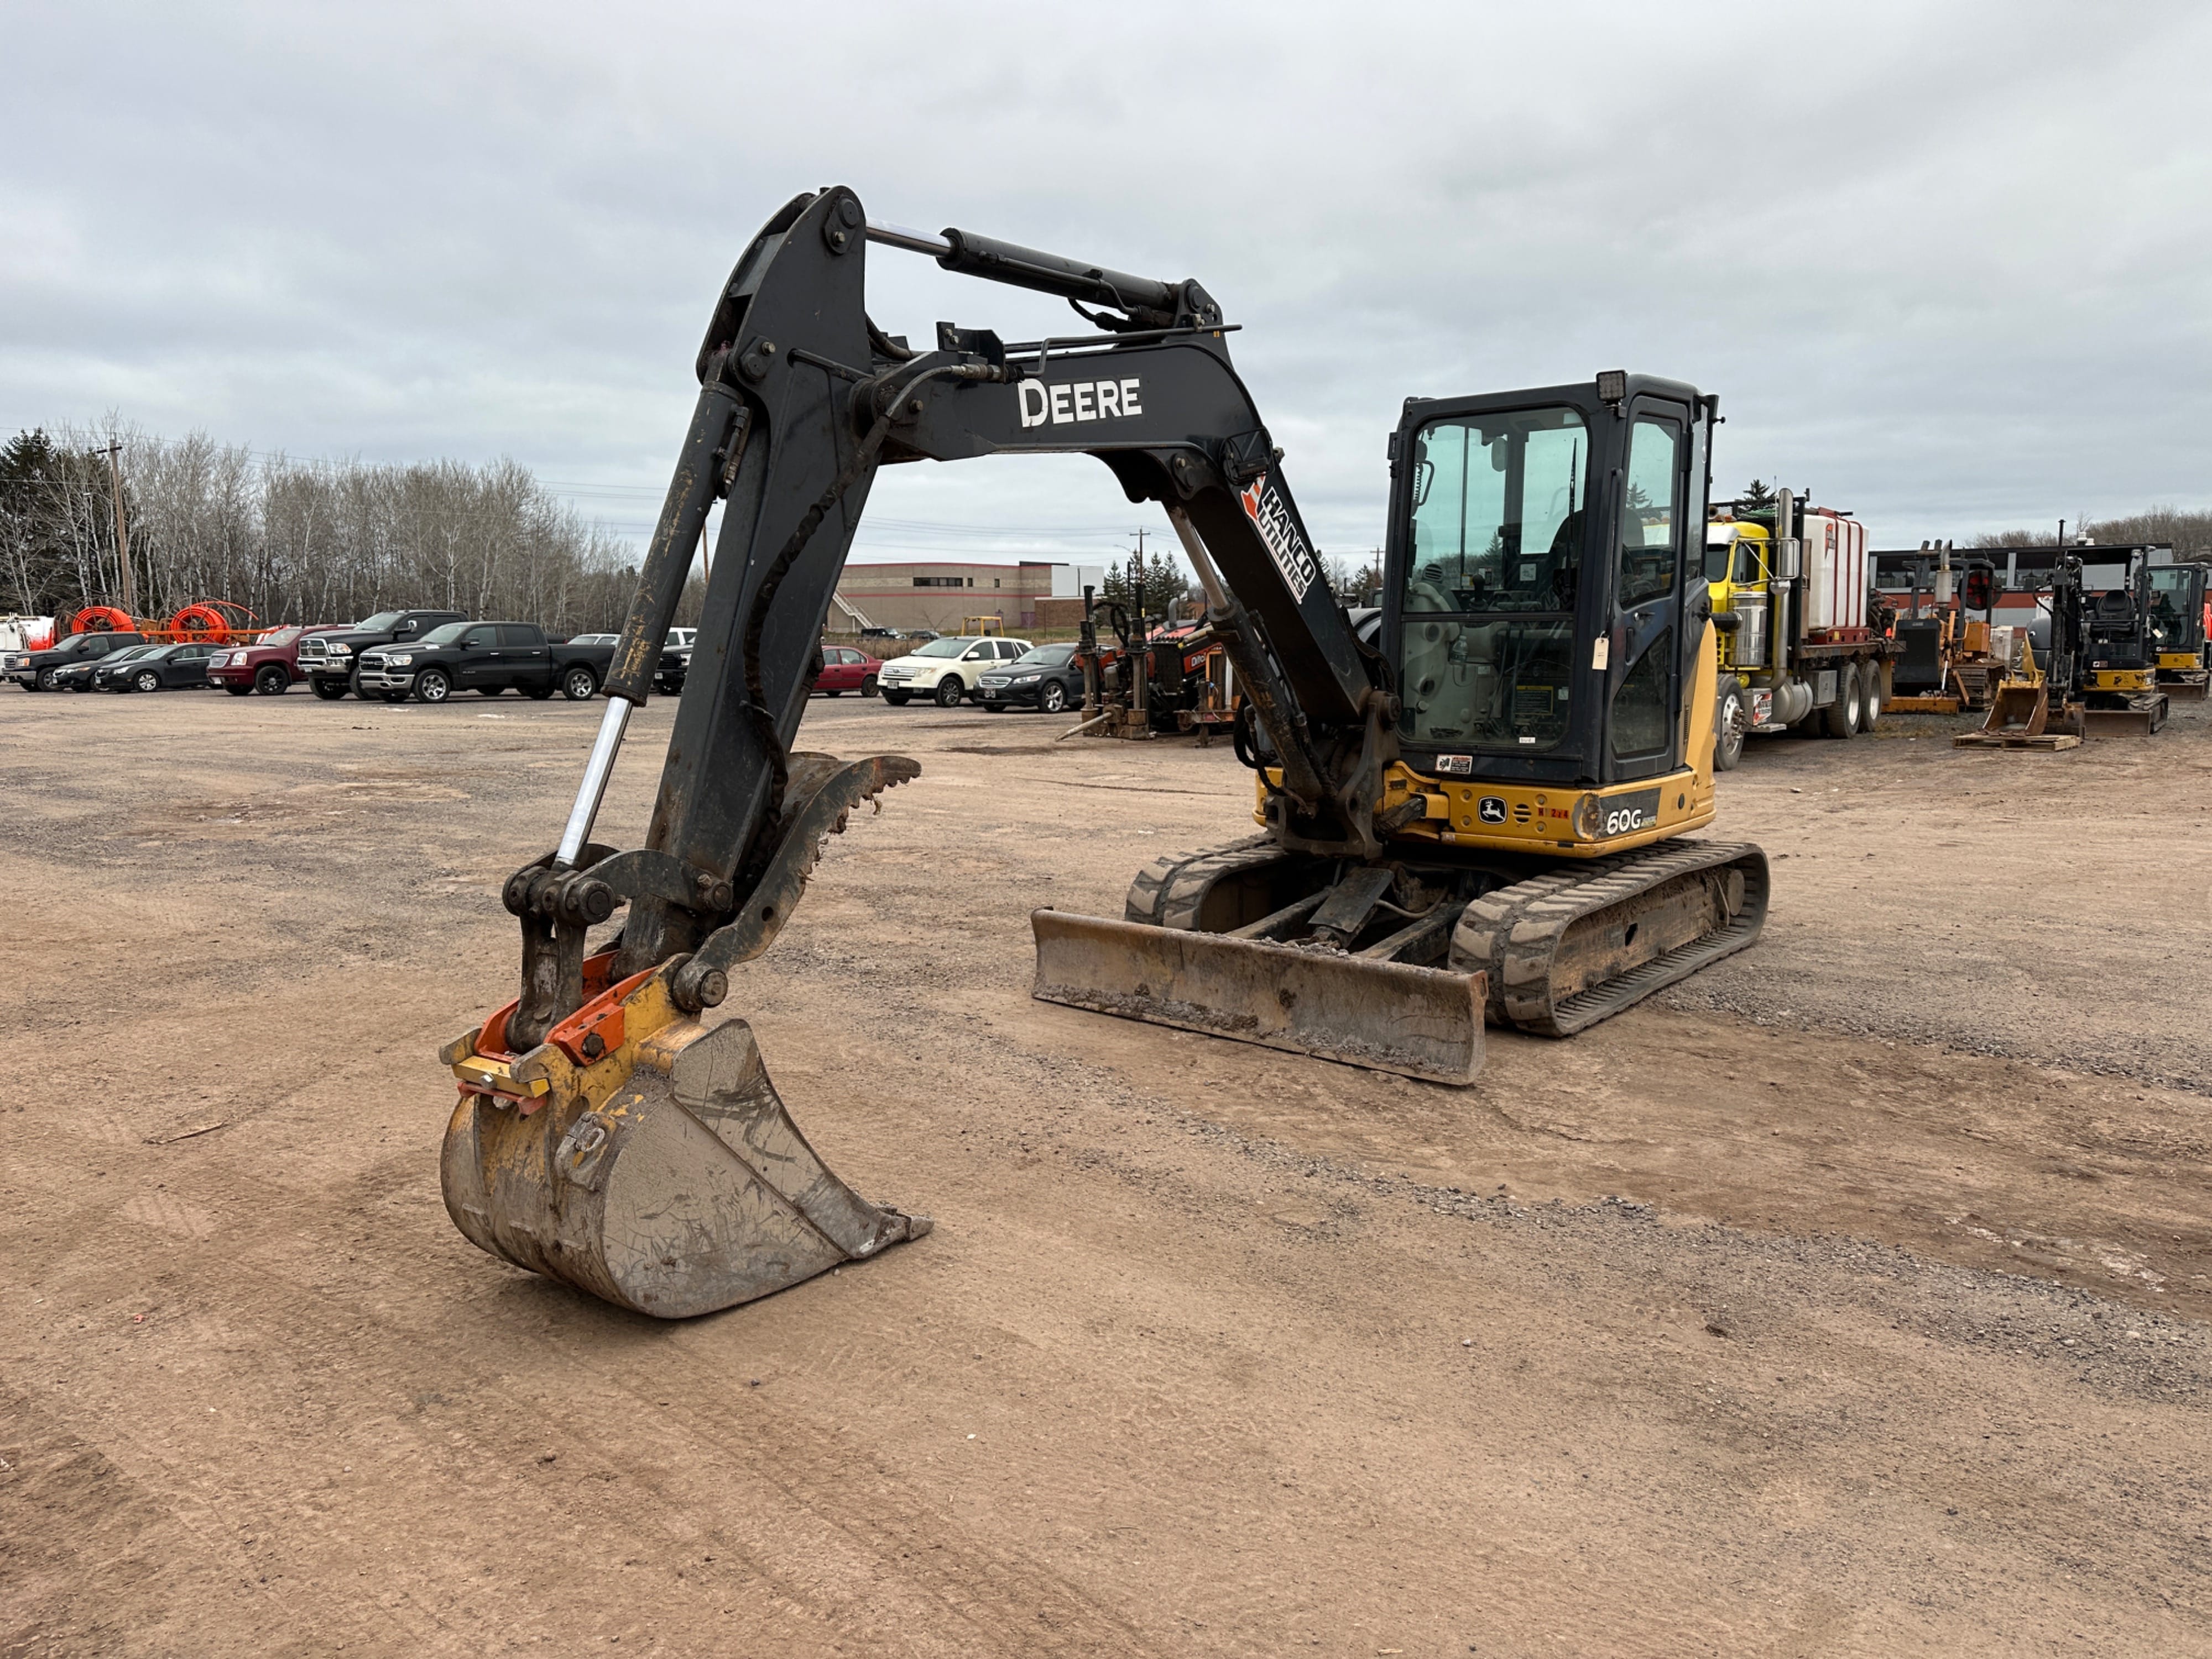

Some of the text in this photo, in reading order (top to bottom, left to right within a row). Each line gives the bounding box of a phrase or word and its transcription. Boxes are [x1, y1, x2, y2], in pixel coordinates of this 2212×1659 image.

[1018, 378, 1142, 427] DEERE
[1257, 508, 1306, 597] UTILITIES
[1263, 487, 1315, 585] HANCO
[1606, 808, 1642, 834] 60G
